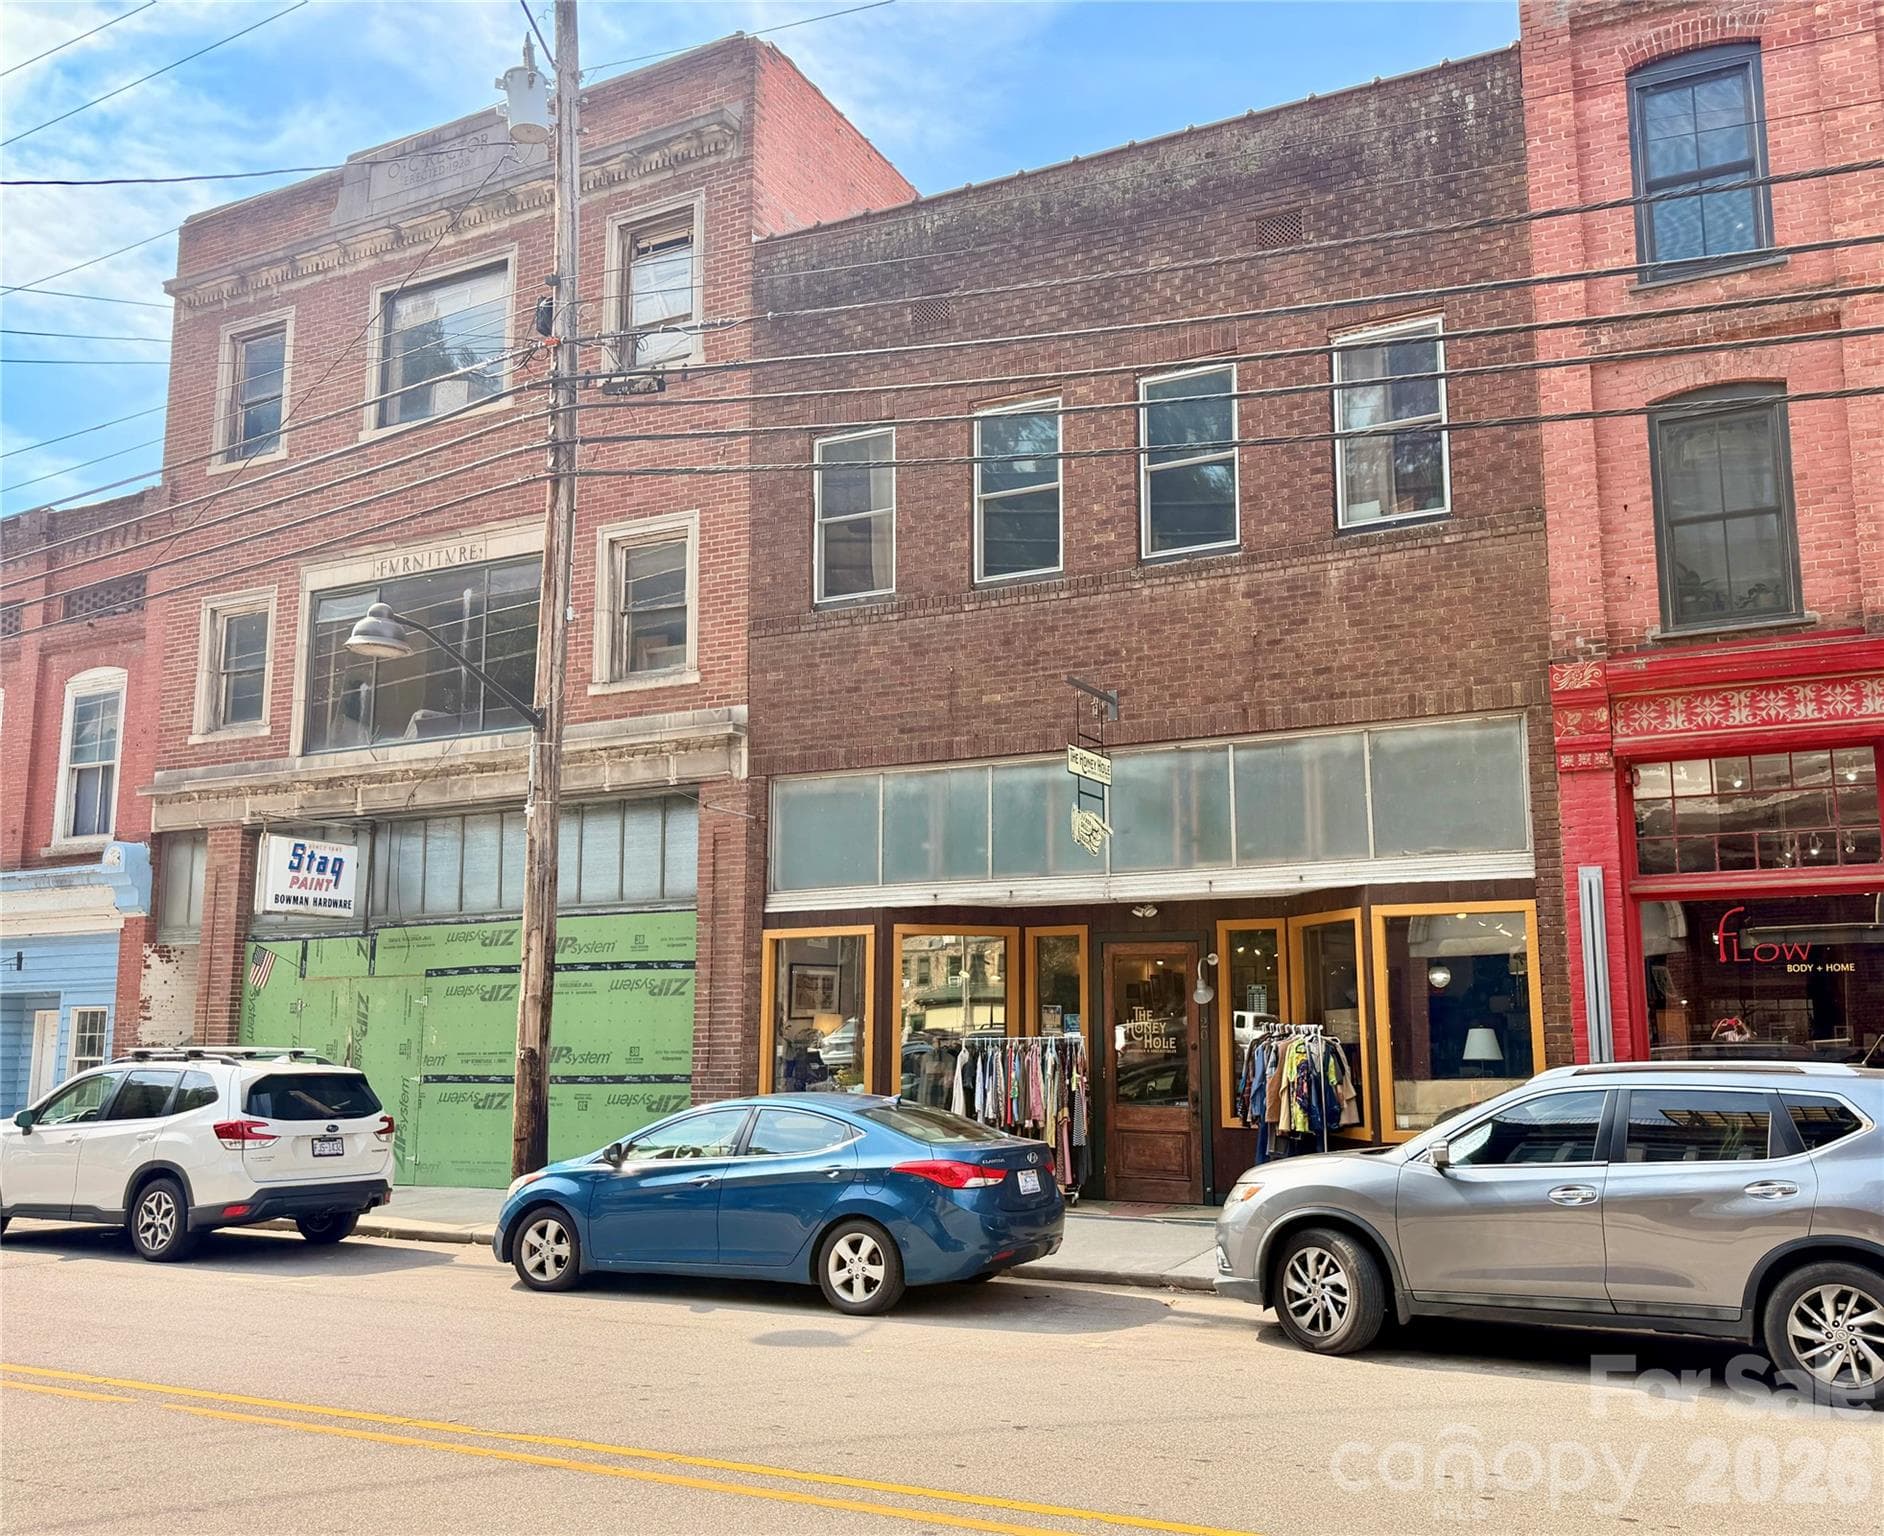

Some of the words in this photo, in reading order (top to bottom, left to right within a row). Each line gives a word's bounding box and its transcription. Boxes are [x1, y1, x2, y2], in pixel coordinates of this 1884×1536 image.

[288, 843, 345, 890] Stag
[289, 875, 334, 892] PAINT
[274, 893, 309, 906] BOWMAN
[312, 897, 353, 910] HARDWARE
[1786, 963, 1813, 973] BODY
[1825, 963, 1856, 973] HOME
[1132, 1006, 1153, 1022] THE
[1126, 1019, 1167, 1040] HONEY
[1144, 1034, 1177, 1049] HOLE
